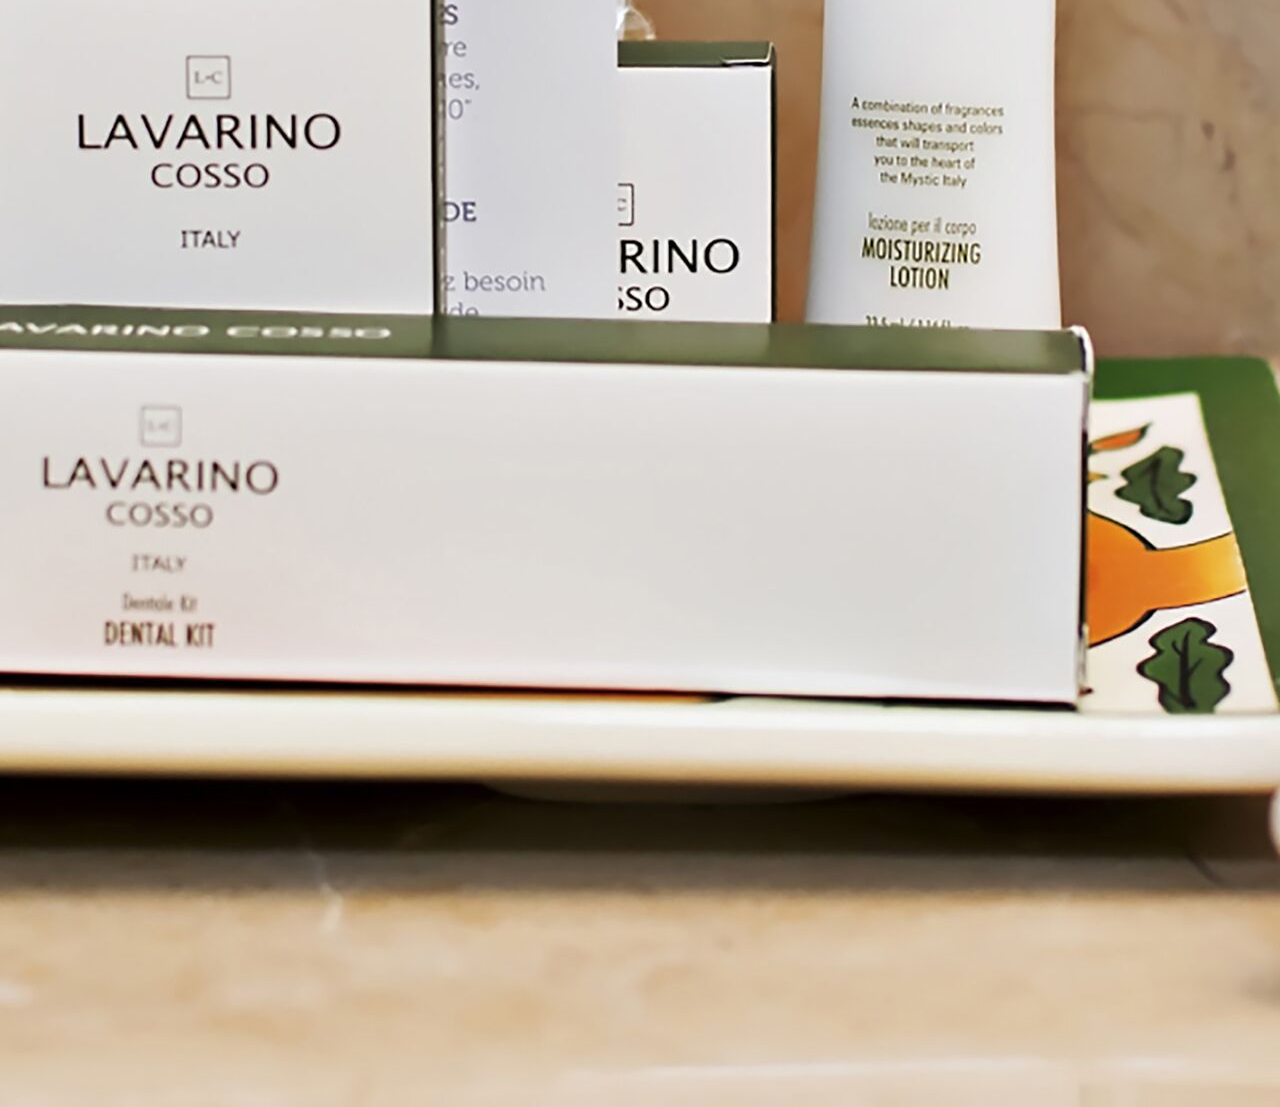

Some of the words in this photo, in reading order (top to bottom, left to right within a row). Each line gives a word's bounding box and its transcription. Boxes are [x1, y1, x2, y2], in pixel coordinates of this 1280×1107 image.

[851, 96, 860, 110] A
[862, 99, 929, 115] combination
[930, 102, 943, 115] of
[945, 103, 1005, 118] fragrances
[77, 113, 341, 150] LAVARINO
[851, 116, 900, 131] essences
[902, 119, 943, 134] shapes
[945, 122, 967, 134] and
[970, 122, 1004, 135] colors
[875, 135, 898, 148] that
[900, 137, 920, 149] will
[922, 139, 974, 153] transport
[874, 155, 894, 168] you
[896, 155, 908, 167] to
[910, 156, 929, 168] the
[931, 157, 962, 169] heart
[963, 157, 976, 170] of
[151, 162, 270, 189] COSSO
[879, 171, 898, 184] the
[900, 172, 939, 187] Mystic
[942, 174, 968, 189] Italy
[180, 229, 241, 249] ITALY
[911, 220, 931, 236] per
[944, 221, 977, 237] corpo
[861, 236, 982, 265] MOISTURIZING
[463, 270, 546, 292] besoin
[889, 265, 950, 290] LOTION
[226, 325, 391, 339] COSSO
[42, 455, 280, 496] LAVARINO
[105, 500, 215, 529] COSSO
[131, 553, 188, 574] ITALY
[104, 620, 177, 648] DENTAL
[186, 622, 216, 648] KIT
